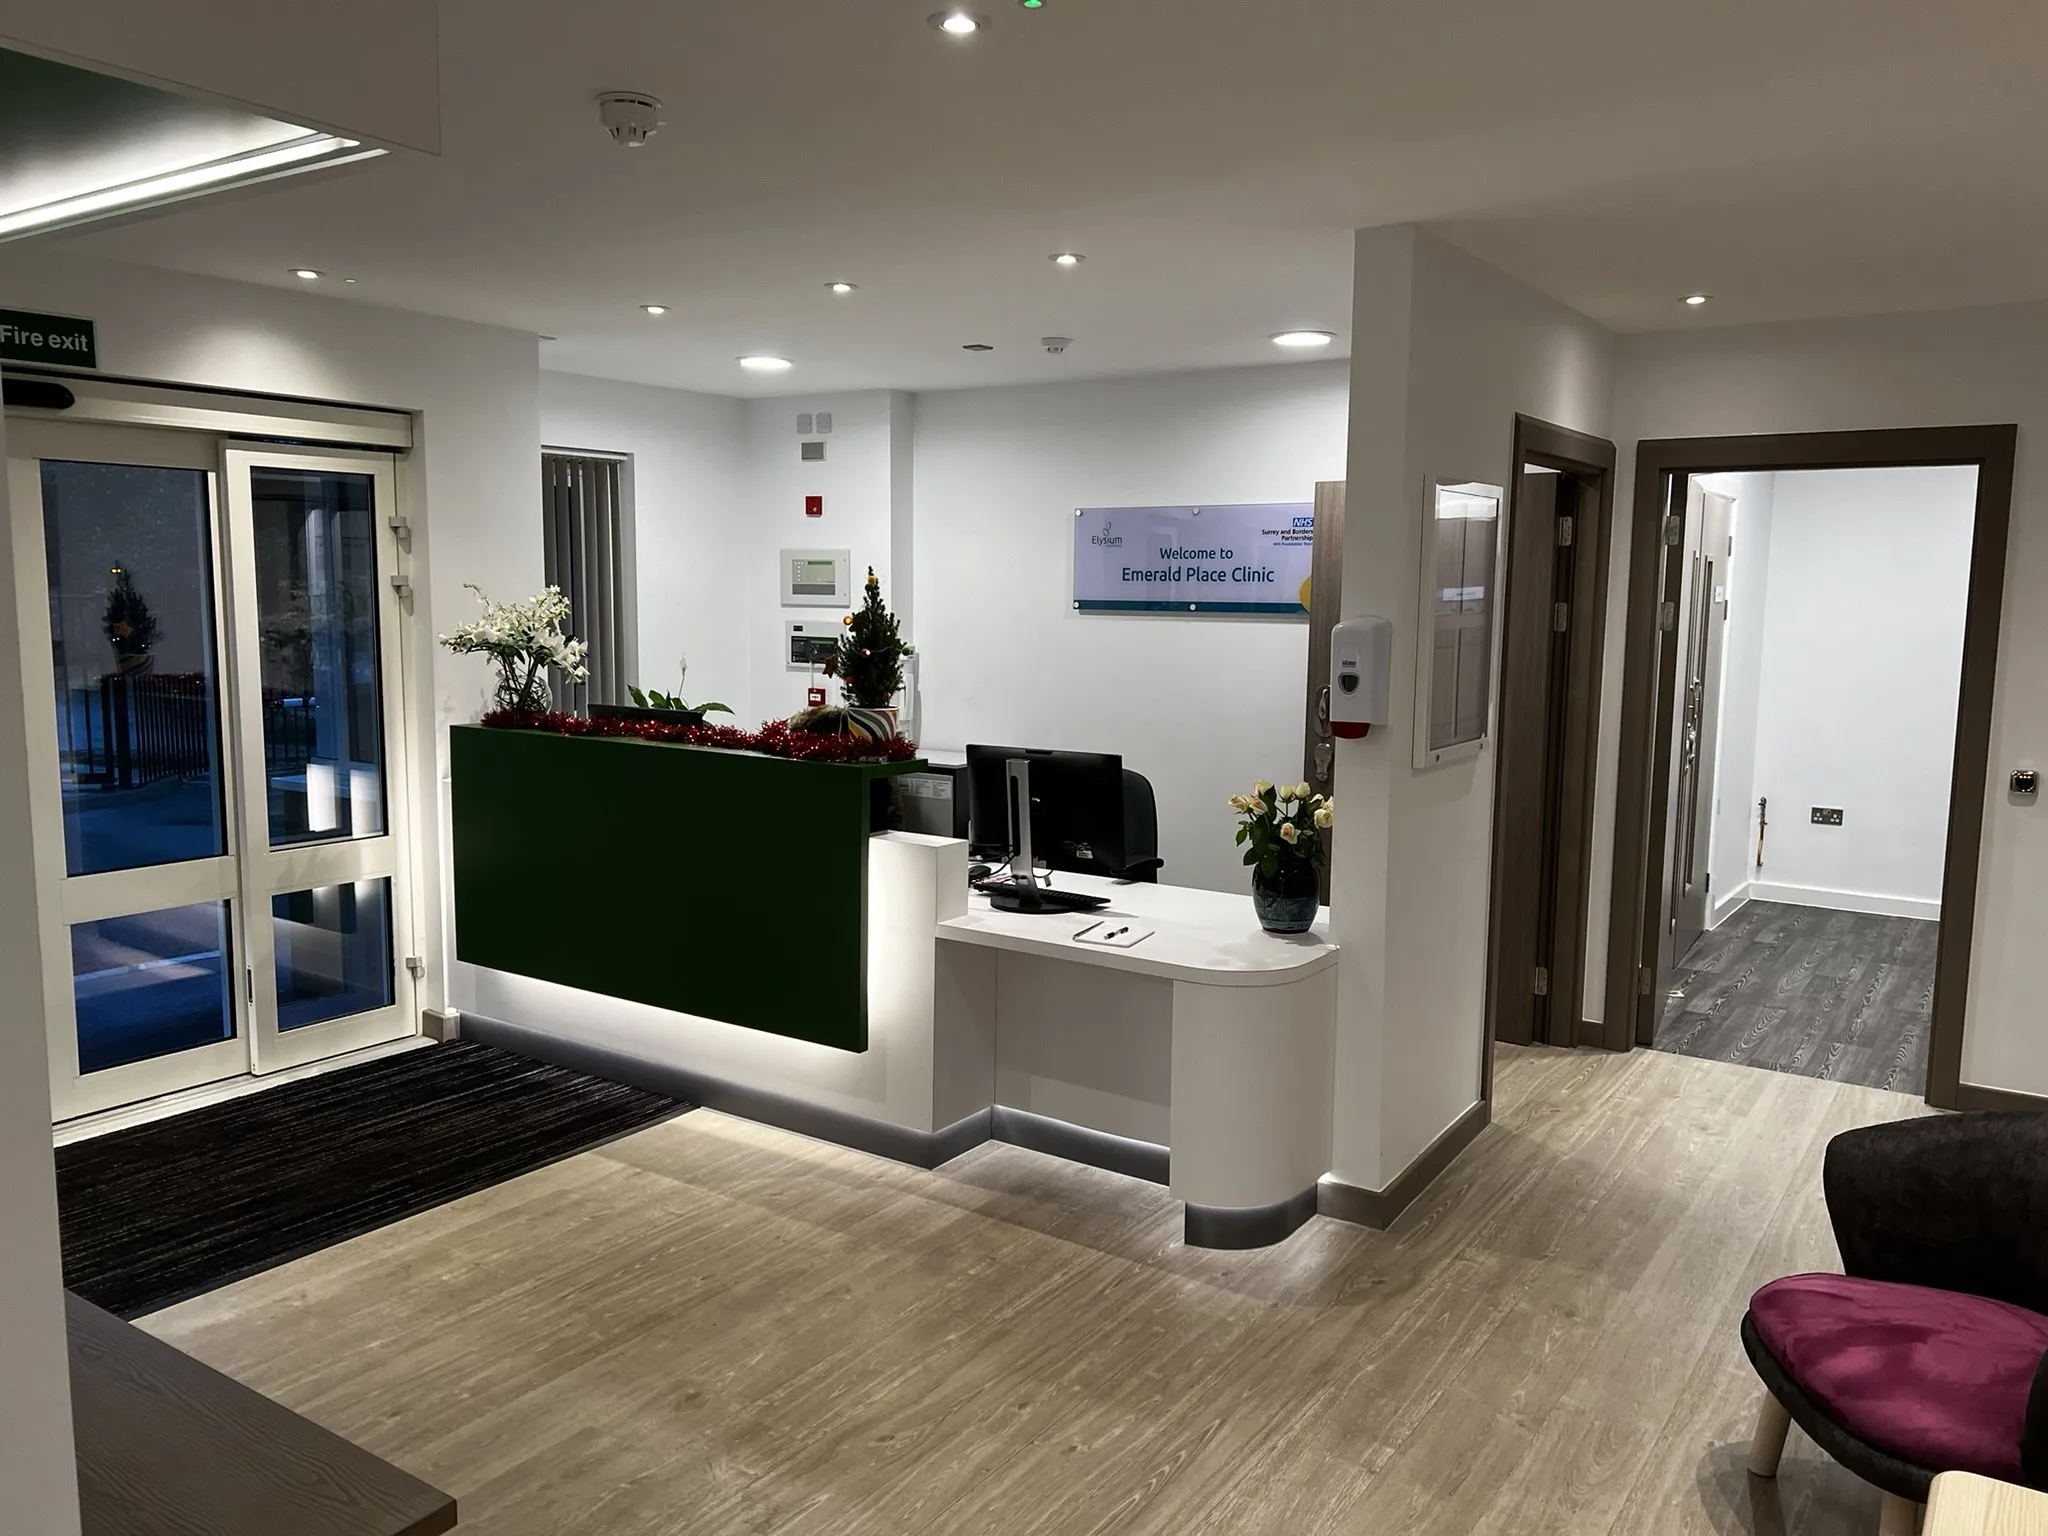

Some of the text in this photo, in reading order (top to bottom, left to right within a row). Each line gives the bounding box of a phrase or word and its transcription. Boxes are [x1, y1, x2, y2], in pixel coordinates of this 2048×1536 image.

[0, 324, 89, 352] Fire exit
[1293, 518, 1313, 527] NHS
[1091, 535, 1123, 546] Elysium
[1159, 547, 1234, 560] Welcome to
[1122, 566, 1275, 583] Emerald Place Clinic
